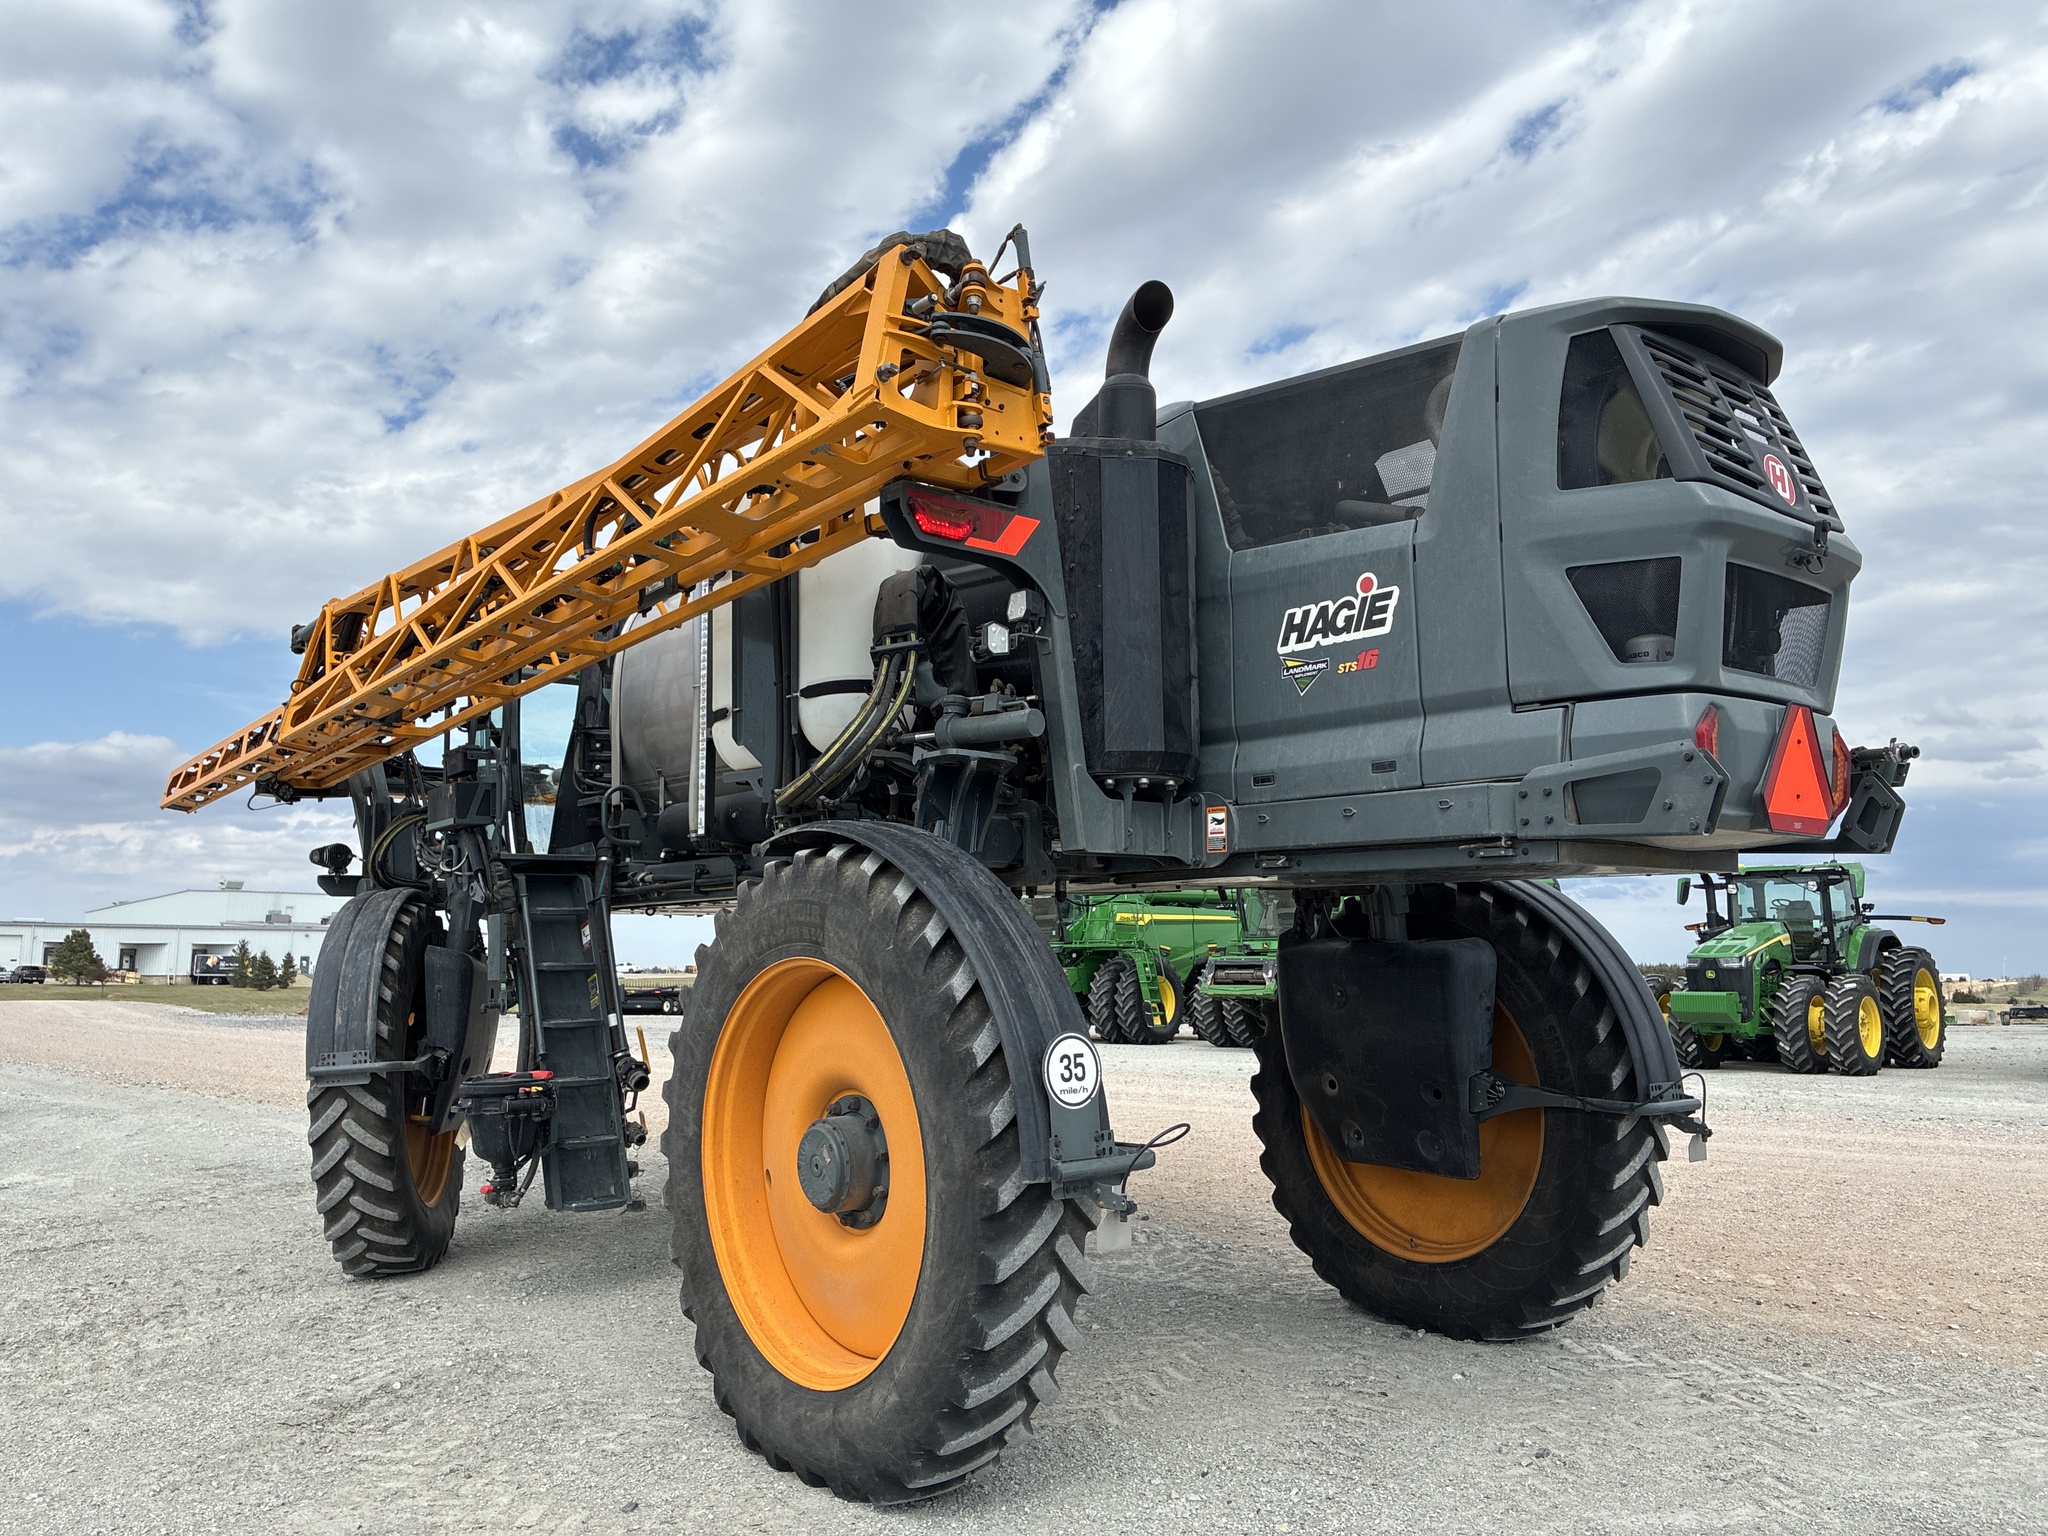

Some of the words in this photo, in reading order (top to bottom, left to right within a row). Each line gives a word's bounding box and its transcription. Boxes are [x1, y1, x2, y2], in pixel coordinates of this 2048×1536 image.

[1279, 574, 1396, 649] HAGIE
[1059, 1053, 1086, 1083] 35
[1060, 1086, 1088, 1095] mile/h
